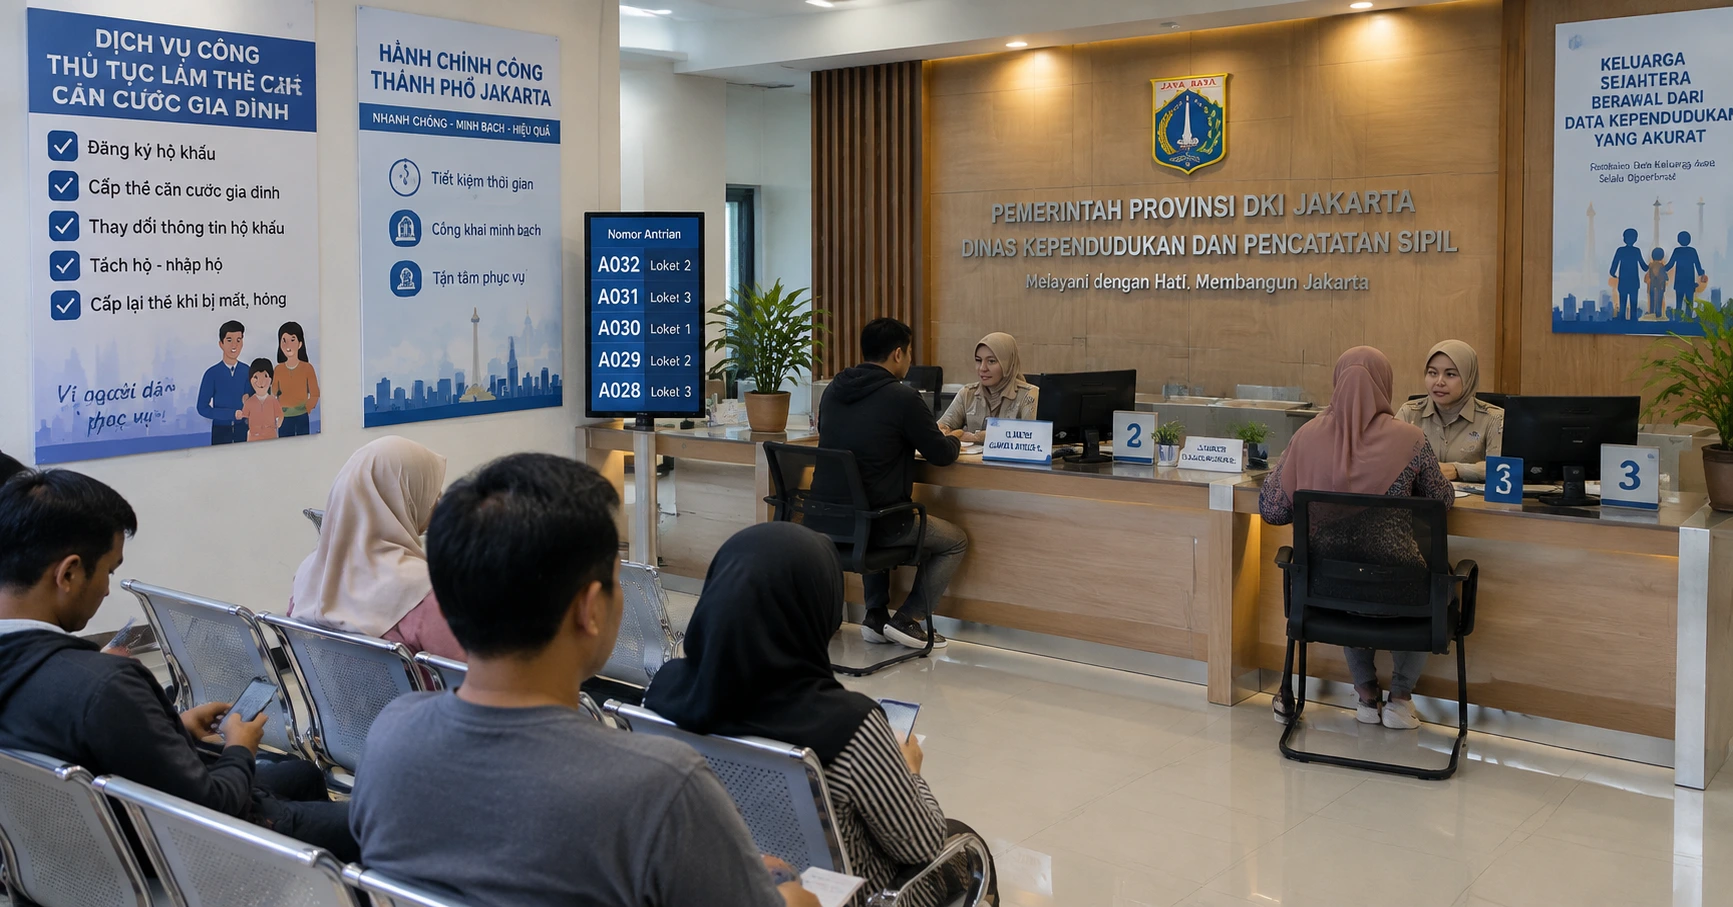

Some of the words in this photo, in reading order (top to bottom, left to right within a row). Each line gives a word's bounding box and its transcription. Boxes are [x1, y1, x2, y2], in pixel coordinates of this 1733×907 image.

[95, 28, 153, 55] DỊCH
[159, 36, 191, 63] VỤ
[197, 37, 260, 65] CÔNG
[496, 56, 543, 82] CÔNG
[1600, 52, 1685, 72] KELUARGA
[105, 60, 155, 86] TỤC
[1600, 71, 1691, 90] SEJAHTERA
[480, 82, 552, 107] JAKARTA
[1591, 92, 1663, 110] BERAWAL
[1667, 89, 1704, 104] DARI
[187, 95, 229, 116] GIA
[372, 112, 410, 126] NHANH
[456, 119, 479, 131] MINH
[1565, 115, 1605, 130] DATA
[1594, 132, 1637, 148] YANG
[1641, 129, 1706, 146] AKURAT
[225, 184, 247, 202] gia
[511, 177, 534, 193] gian
[991, 199, 1122, 224] PEMERINTAH
[1129, 194, 1235, 220] PROVINSI
[1243, 193, 1285, 217] DKI
[1293, 189, 1416, 216] JAKARTA
[88, 218, 128, 238] Thay
[207, 220, 227, 235] tin
[231, 220, 248, 238] hộ
[464, 223, 487, 236] khai
[489, 224, 515, 236] minh
[608, 228, 642, 239] Nomor
[644, 228, 681, 239] Antrian
[961, 238, 1017, 257] DINAS
[1023, 235, 1185, 256] KEPENDUDUKAN
[1192, 234, 1237, 255] DAN
[1244, 231, 1390, 254] PENCATATAN
[1397, 230, 1459, 253] SIPIL
[597, 256, 640, 273] A032
[650, 261, 680, 271] Loket
[684, 260, 691, 271] 2
[1093, 273, 1150, 293] dengan
[1195, 273, 1298, 294] Membangun
[1302, 272, 1369, 290] Jakarta
[126, 295, 144, 314] lại
[176, 293, 198, 309] khi
[202, 293, 215, 312] bị
[597, 288, 638, 305] A031
[650, 293, 680, 303] Loket
[684, 292, 691, 303] 3
[598, 320, 641, 336] A030
[650, 324, 680, 335] Loket
[685, 324, 691, 334] 1
[598, 352, 641, 368] A029
[650, 356, 680, 366] Loket
[684, 355, 691, 366] 2
[598, 382, 641, 398] A028
[651, 387, 680, 397] Loket
[684, 386, 691, 397] 3
[1126, 423, 1142, 448] 2
[1618, 460, 1641, 491] 3
